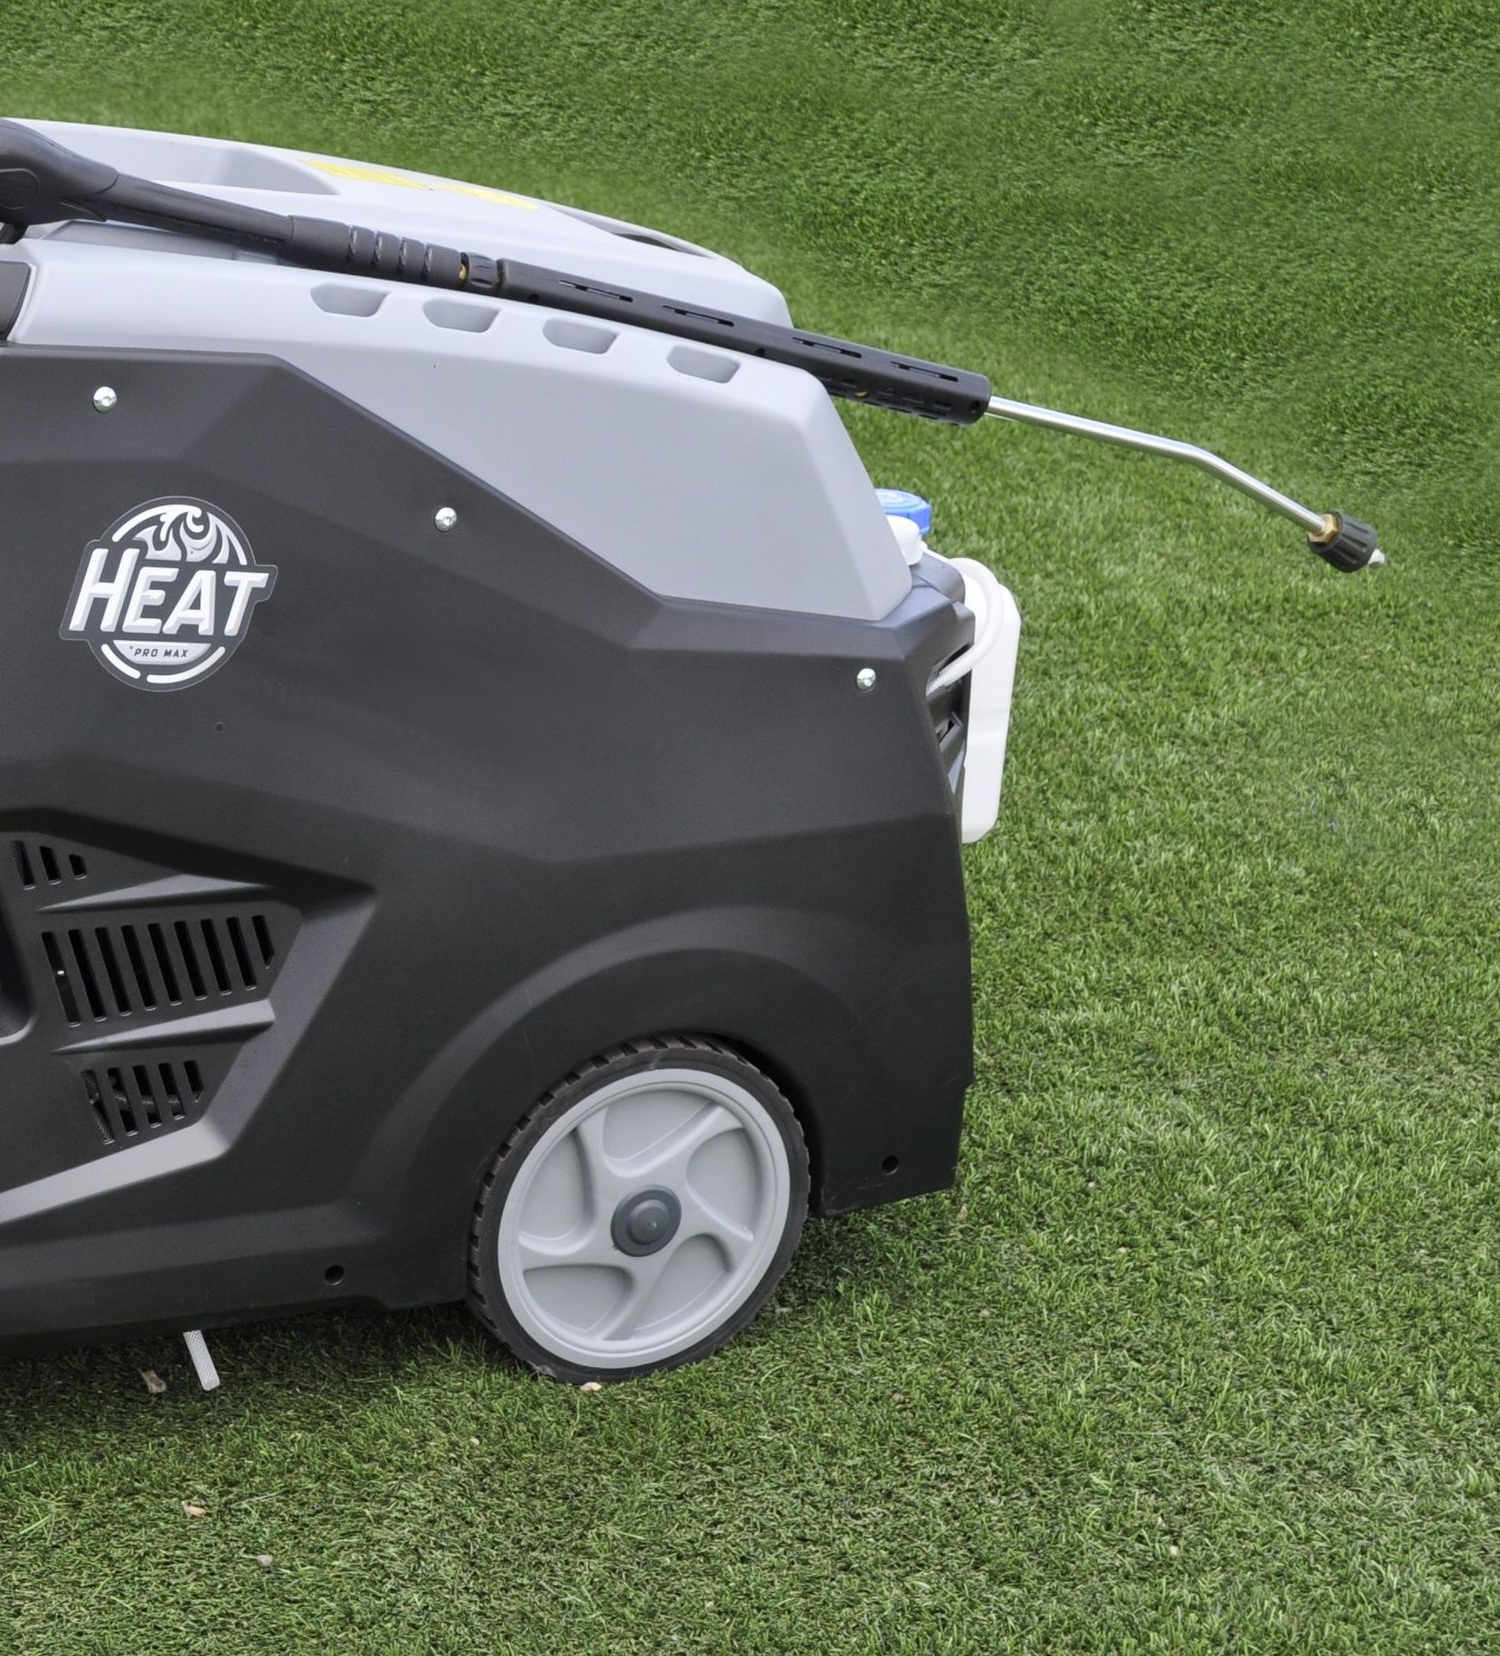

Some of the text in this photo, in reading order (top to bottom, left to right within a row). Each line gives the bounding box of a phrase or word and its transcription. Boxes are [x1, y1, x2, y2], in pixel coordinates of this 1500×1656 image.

[68, 548, 270, 637] HEAT
[134, 648, 189, 658] PRO MAX
